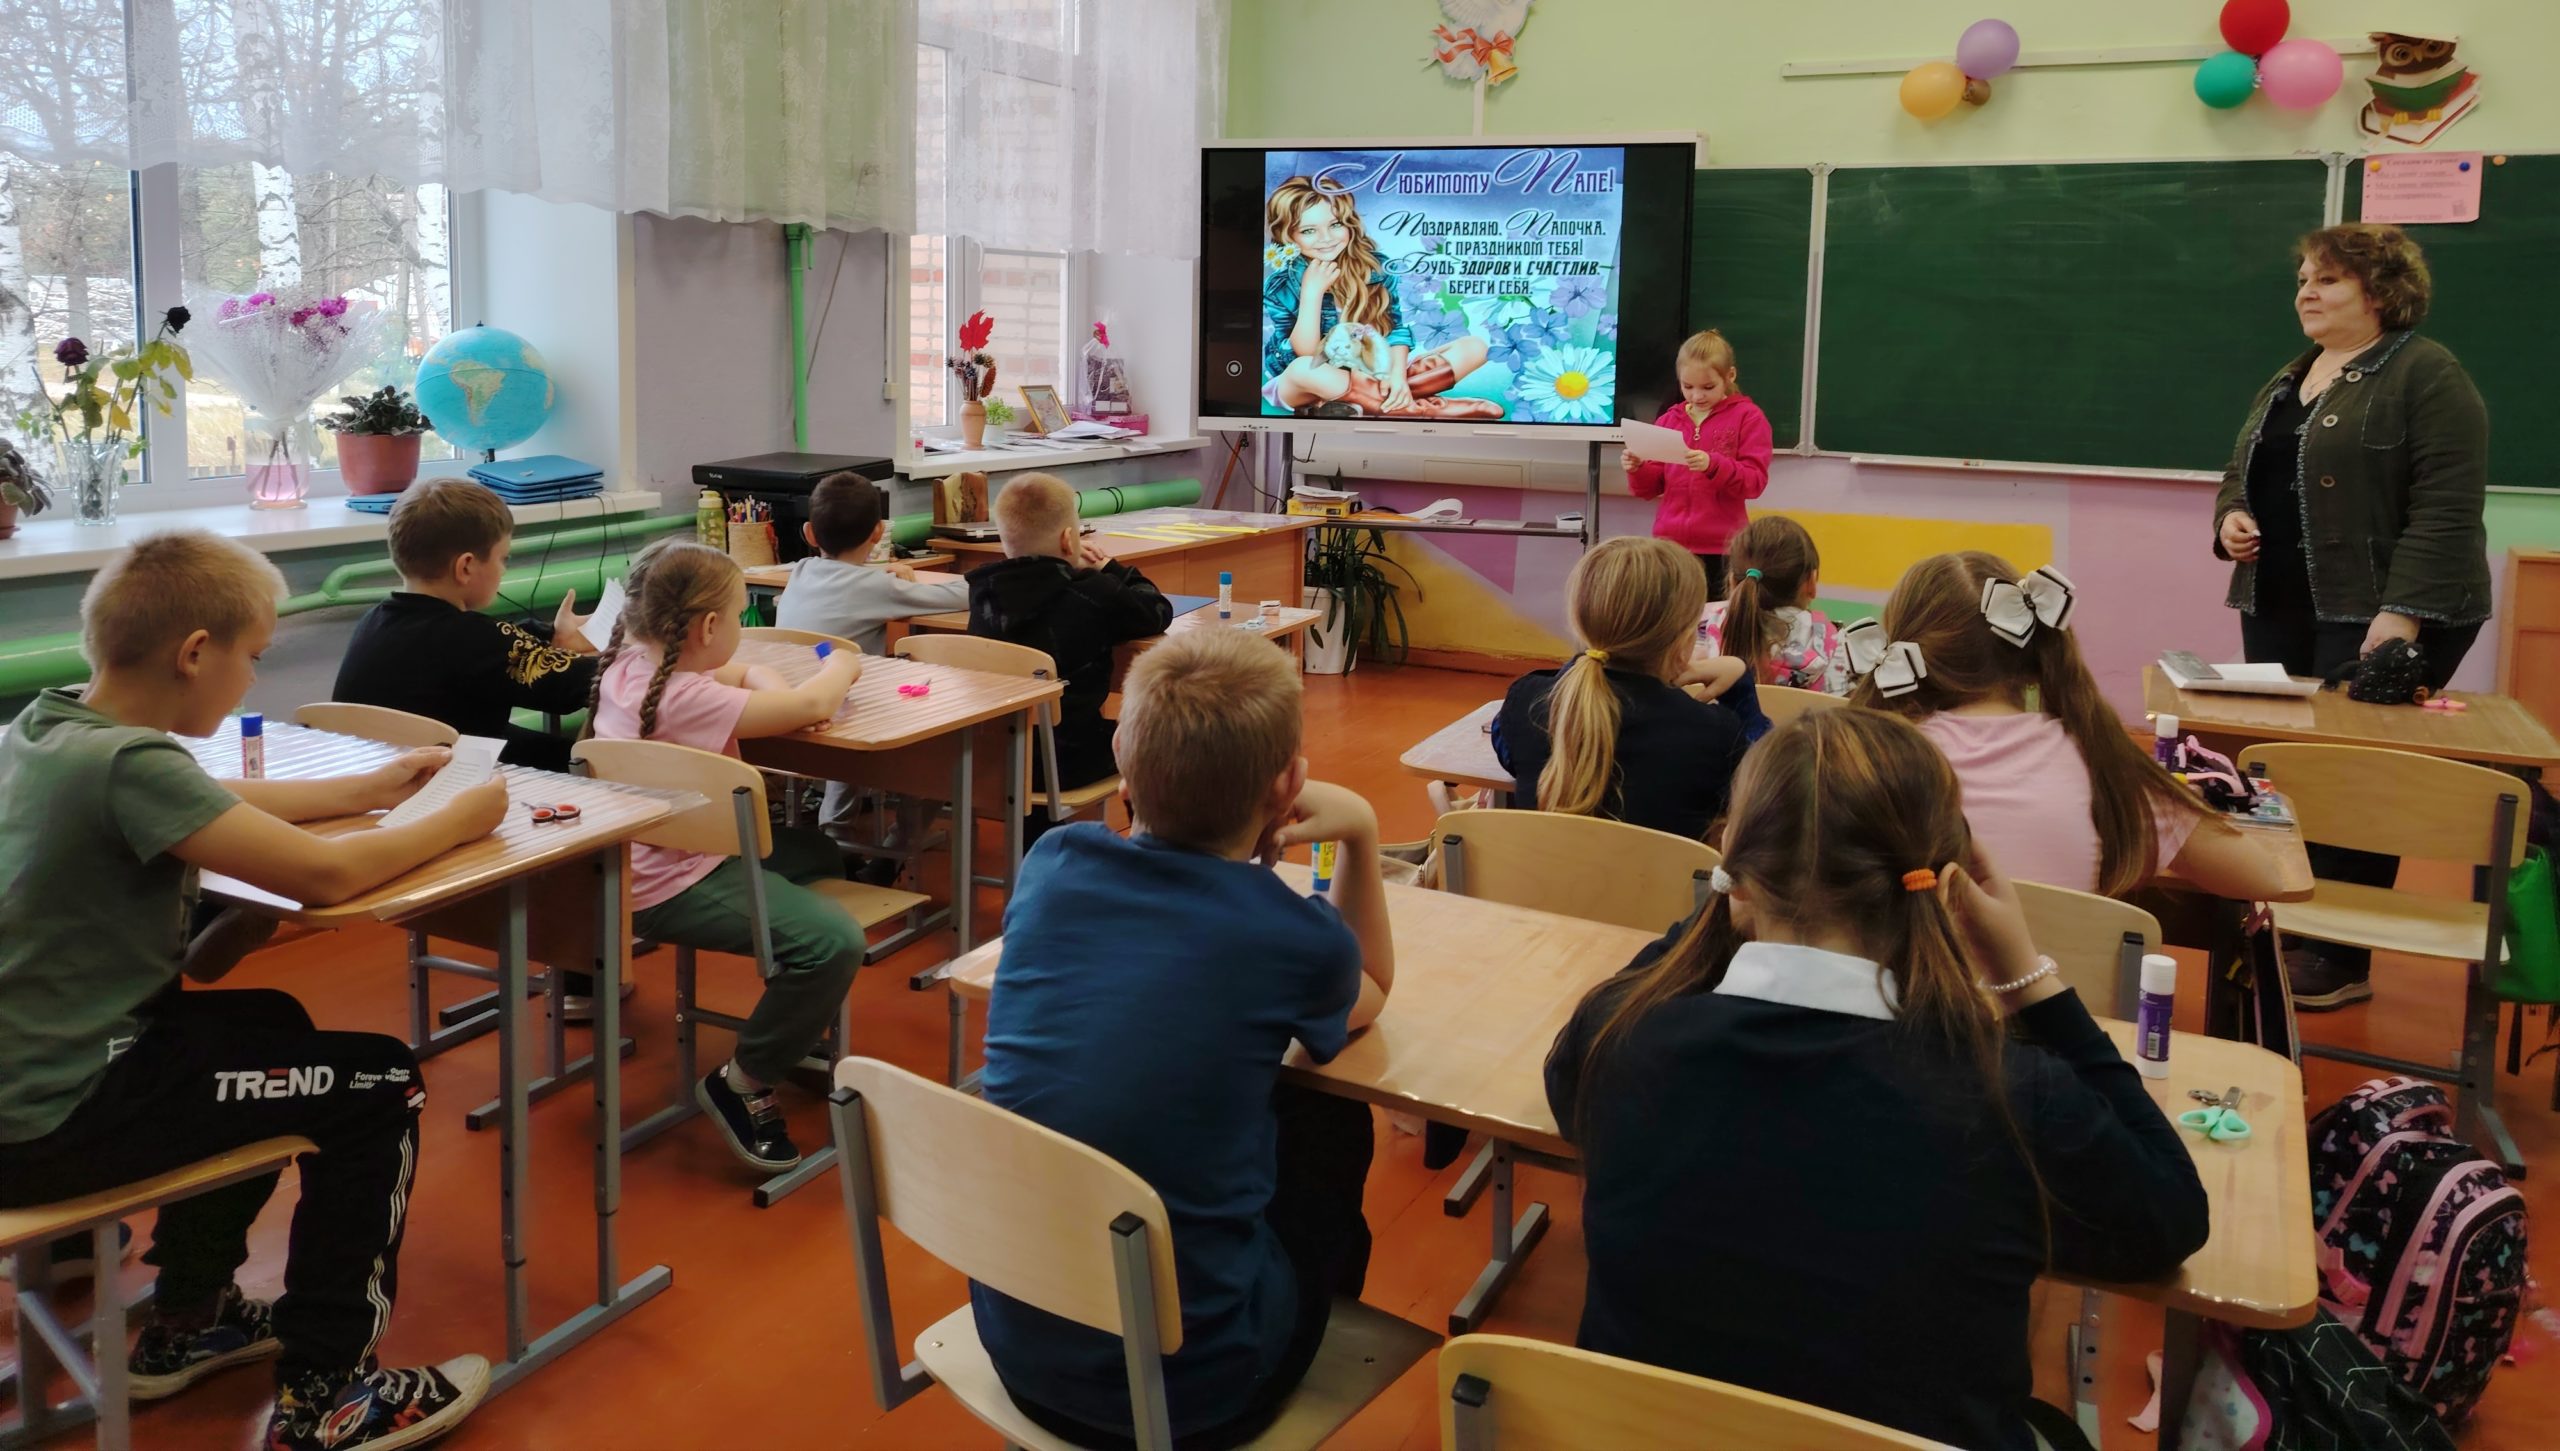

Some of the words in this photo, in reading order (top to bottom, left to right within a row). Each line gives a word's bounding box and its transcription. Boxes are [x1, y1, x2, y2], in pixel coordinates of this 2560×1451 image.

[1456, 241, 1543, 256] ПРАЗДНИКОМ
[1548, 238, 1583, 256] ТЕБЯ!
[1459, 260, 1512, 276] ЗДОРОВ
[1513, 260, 1522, 276] И
[1449, 280, 1495, 295] БЕРЕГИ
[214, 1065, 335, 1102] TREND
